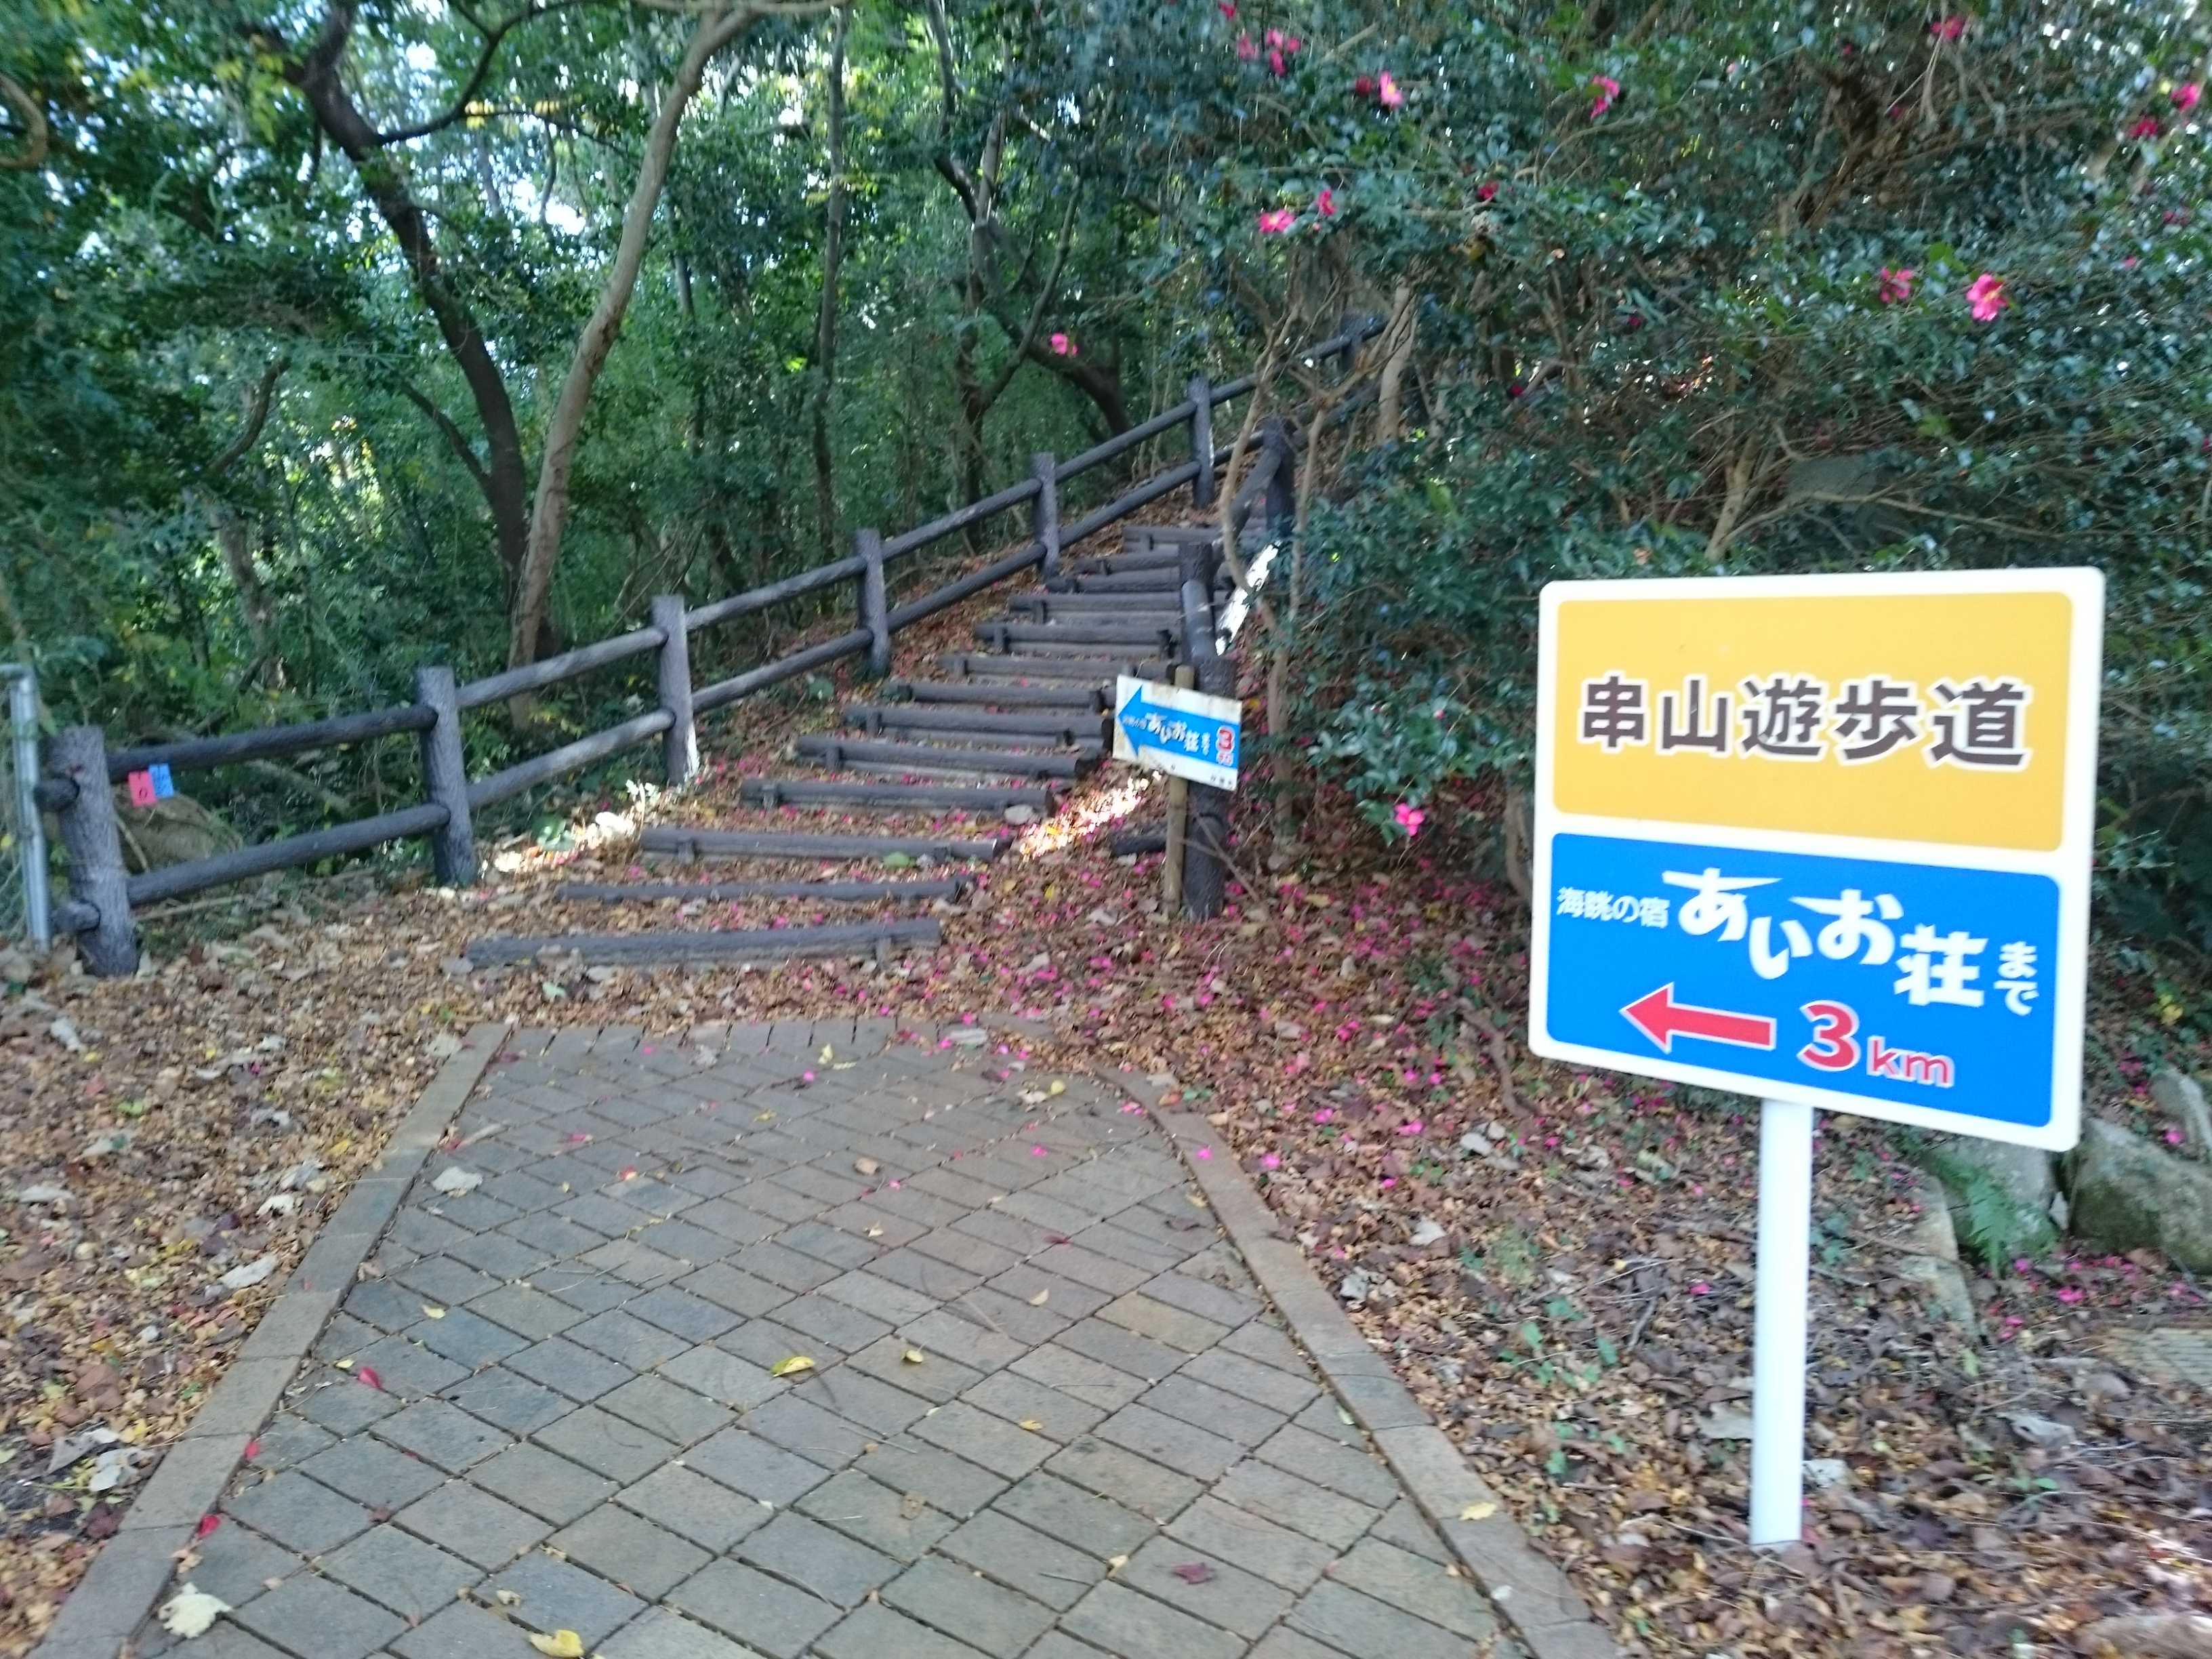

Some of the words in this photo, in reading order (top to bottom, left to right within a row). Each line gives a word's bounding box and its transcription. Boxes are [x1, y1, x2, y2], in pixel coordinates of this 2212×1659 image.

[1582, 674, 2026, 766] 串山遊歩道
[1556, 886, 1670, 928] 海眺の宿
[1662, 867, 1988, 1008] あいお荘
[1994, 941, 2039, 1016] まで
